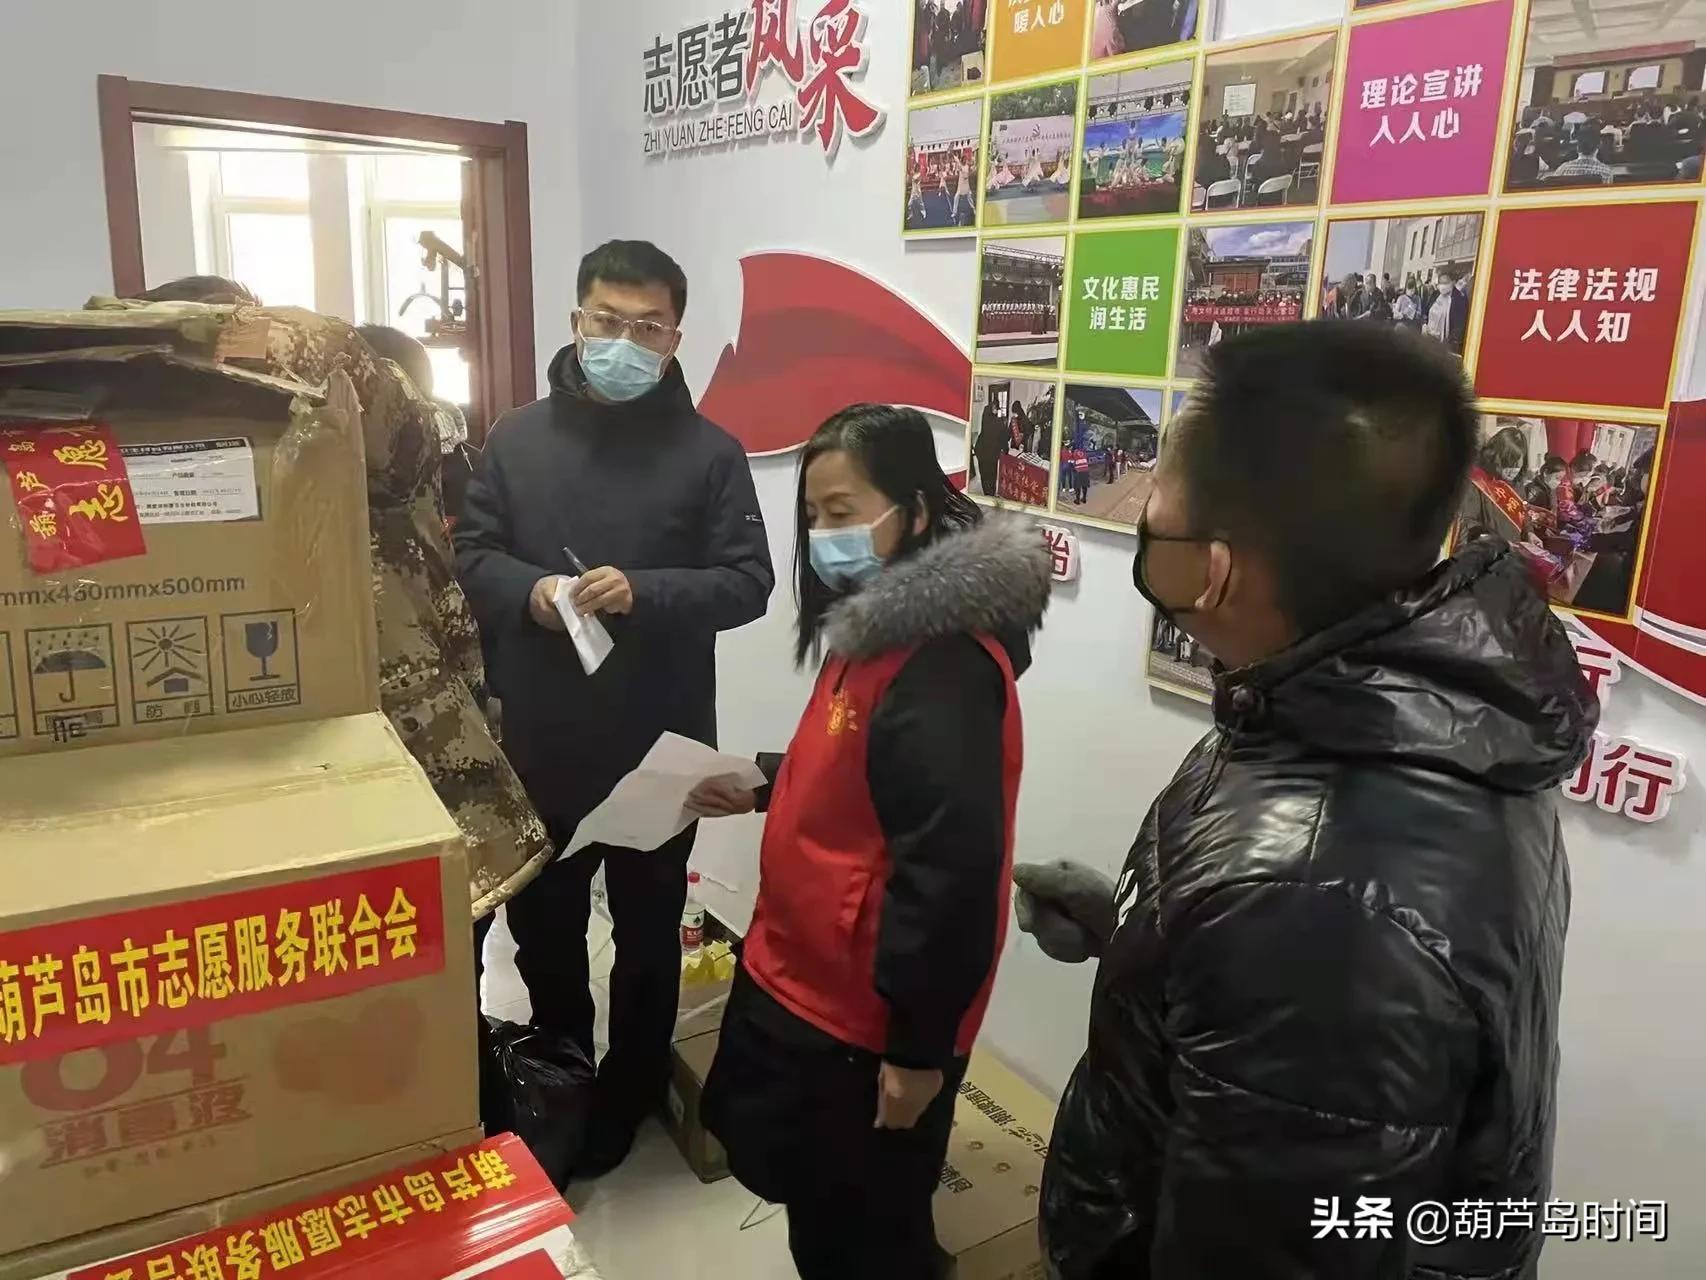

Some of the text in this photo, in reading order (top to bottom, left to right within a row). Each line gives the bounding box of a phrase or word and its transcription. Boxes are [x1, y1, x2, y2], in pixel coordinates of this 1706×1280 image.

[1014, 1, 1064, 33] 暖人心
[1360, 63, 1484, 110] 理论宣讲
[644, 103, 792, 152] ZHI YUAN ZHE FENG CAI
[1082, 275, 1161, 302] 文化惠民
[1509, 267, 1659, 302] 法律法规
[1089, 306, 1148, 331] 润生活
[1520, 309, 1632, 344] 人人知
[104, 1149, 518, 1280] 葫芦岛市志愿服务联
